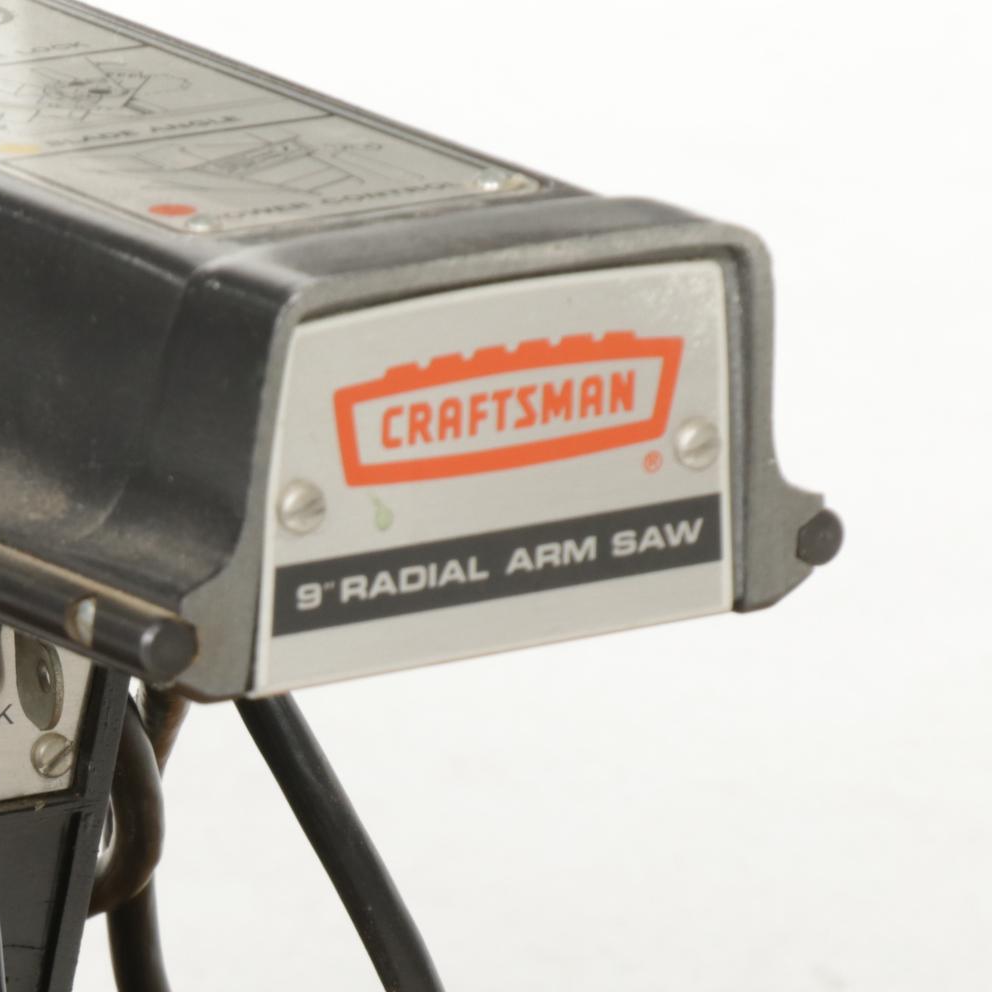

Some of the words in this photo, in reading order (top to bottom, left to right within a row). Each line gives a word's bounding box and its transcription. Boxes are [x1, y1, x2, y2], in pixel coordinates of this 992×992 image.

[380, 369, 636, 450] CRAFTSMAN
[340, 555, 490, 606] RADIAL
[505, 535, 598, 577] ARM
[610, 517, 705, 558] SAW
